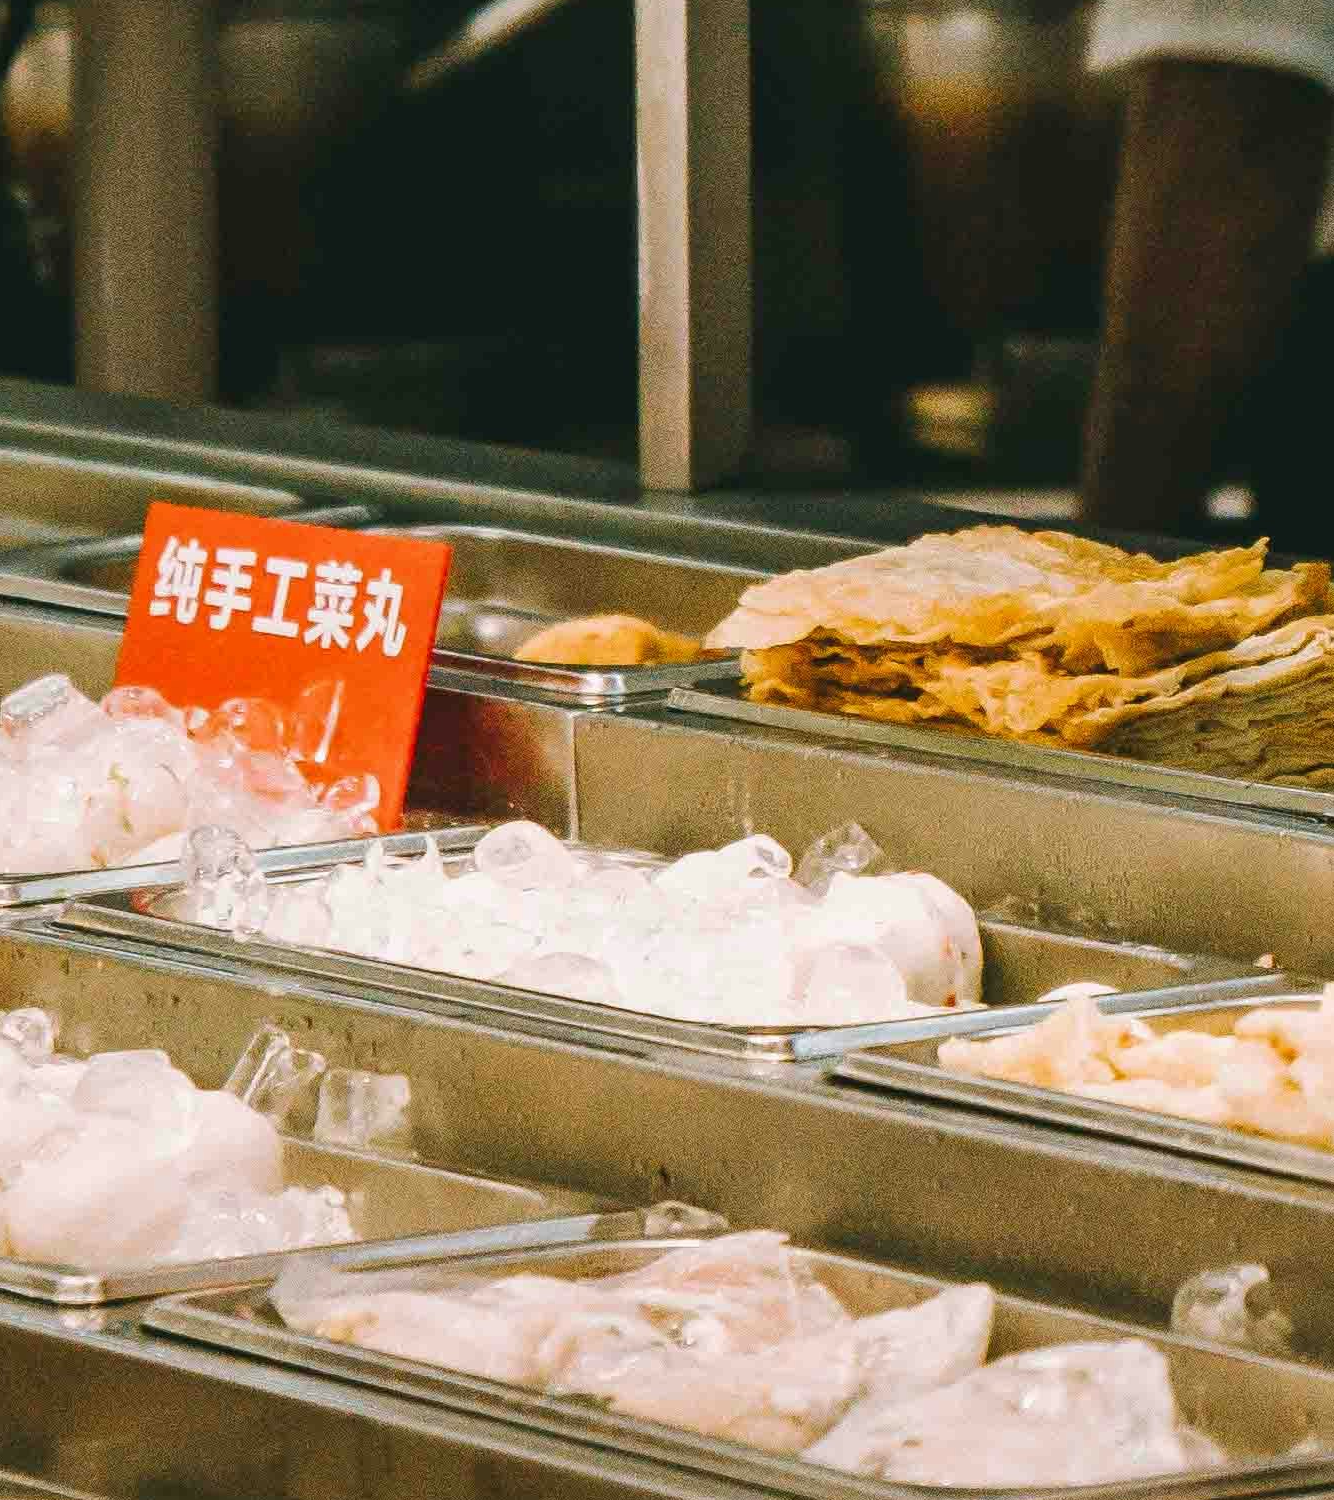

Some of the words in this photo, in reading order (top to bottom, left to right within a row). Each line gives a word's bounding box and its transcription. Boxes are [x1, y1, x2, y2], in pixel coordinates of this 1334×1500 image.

[149, 535, 408, 657] 纯手工菜丸
